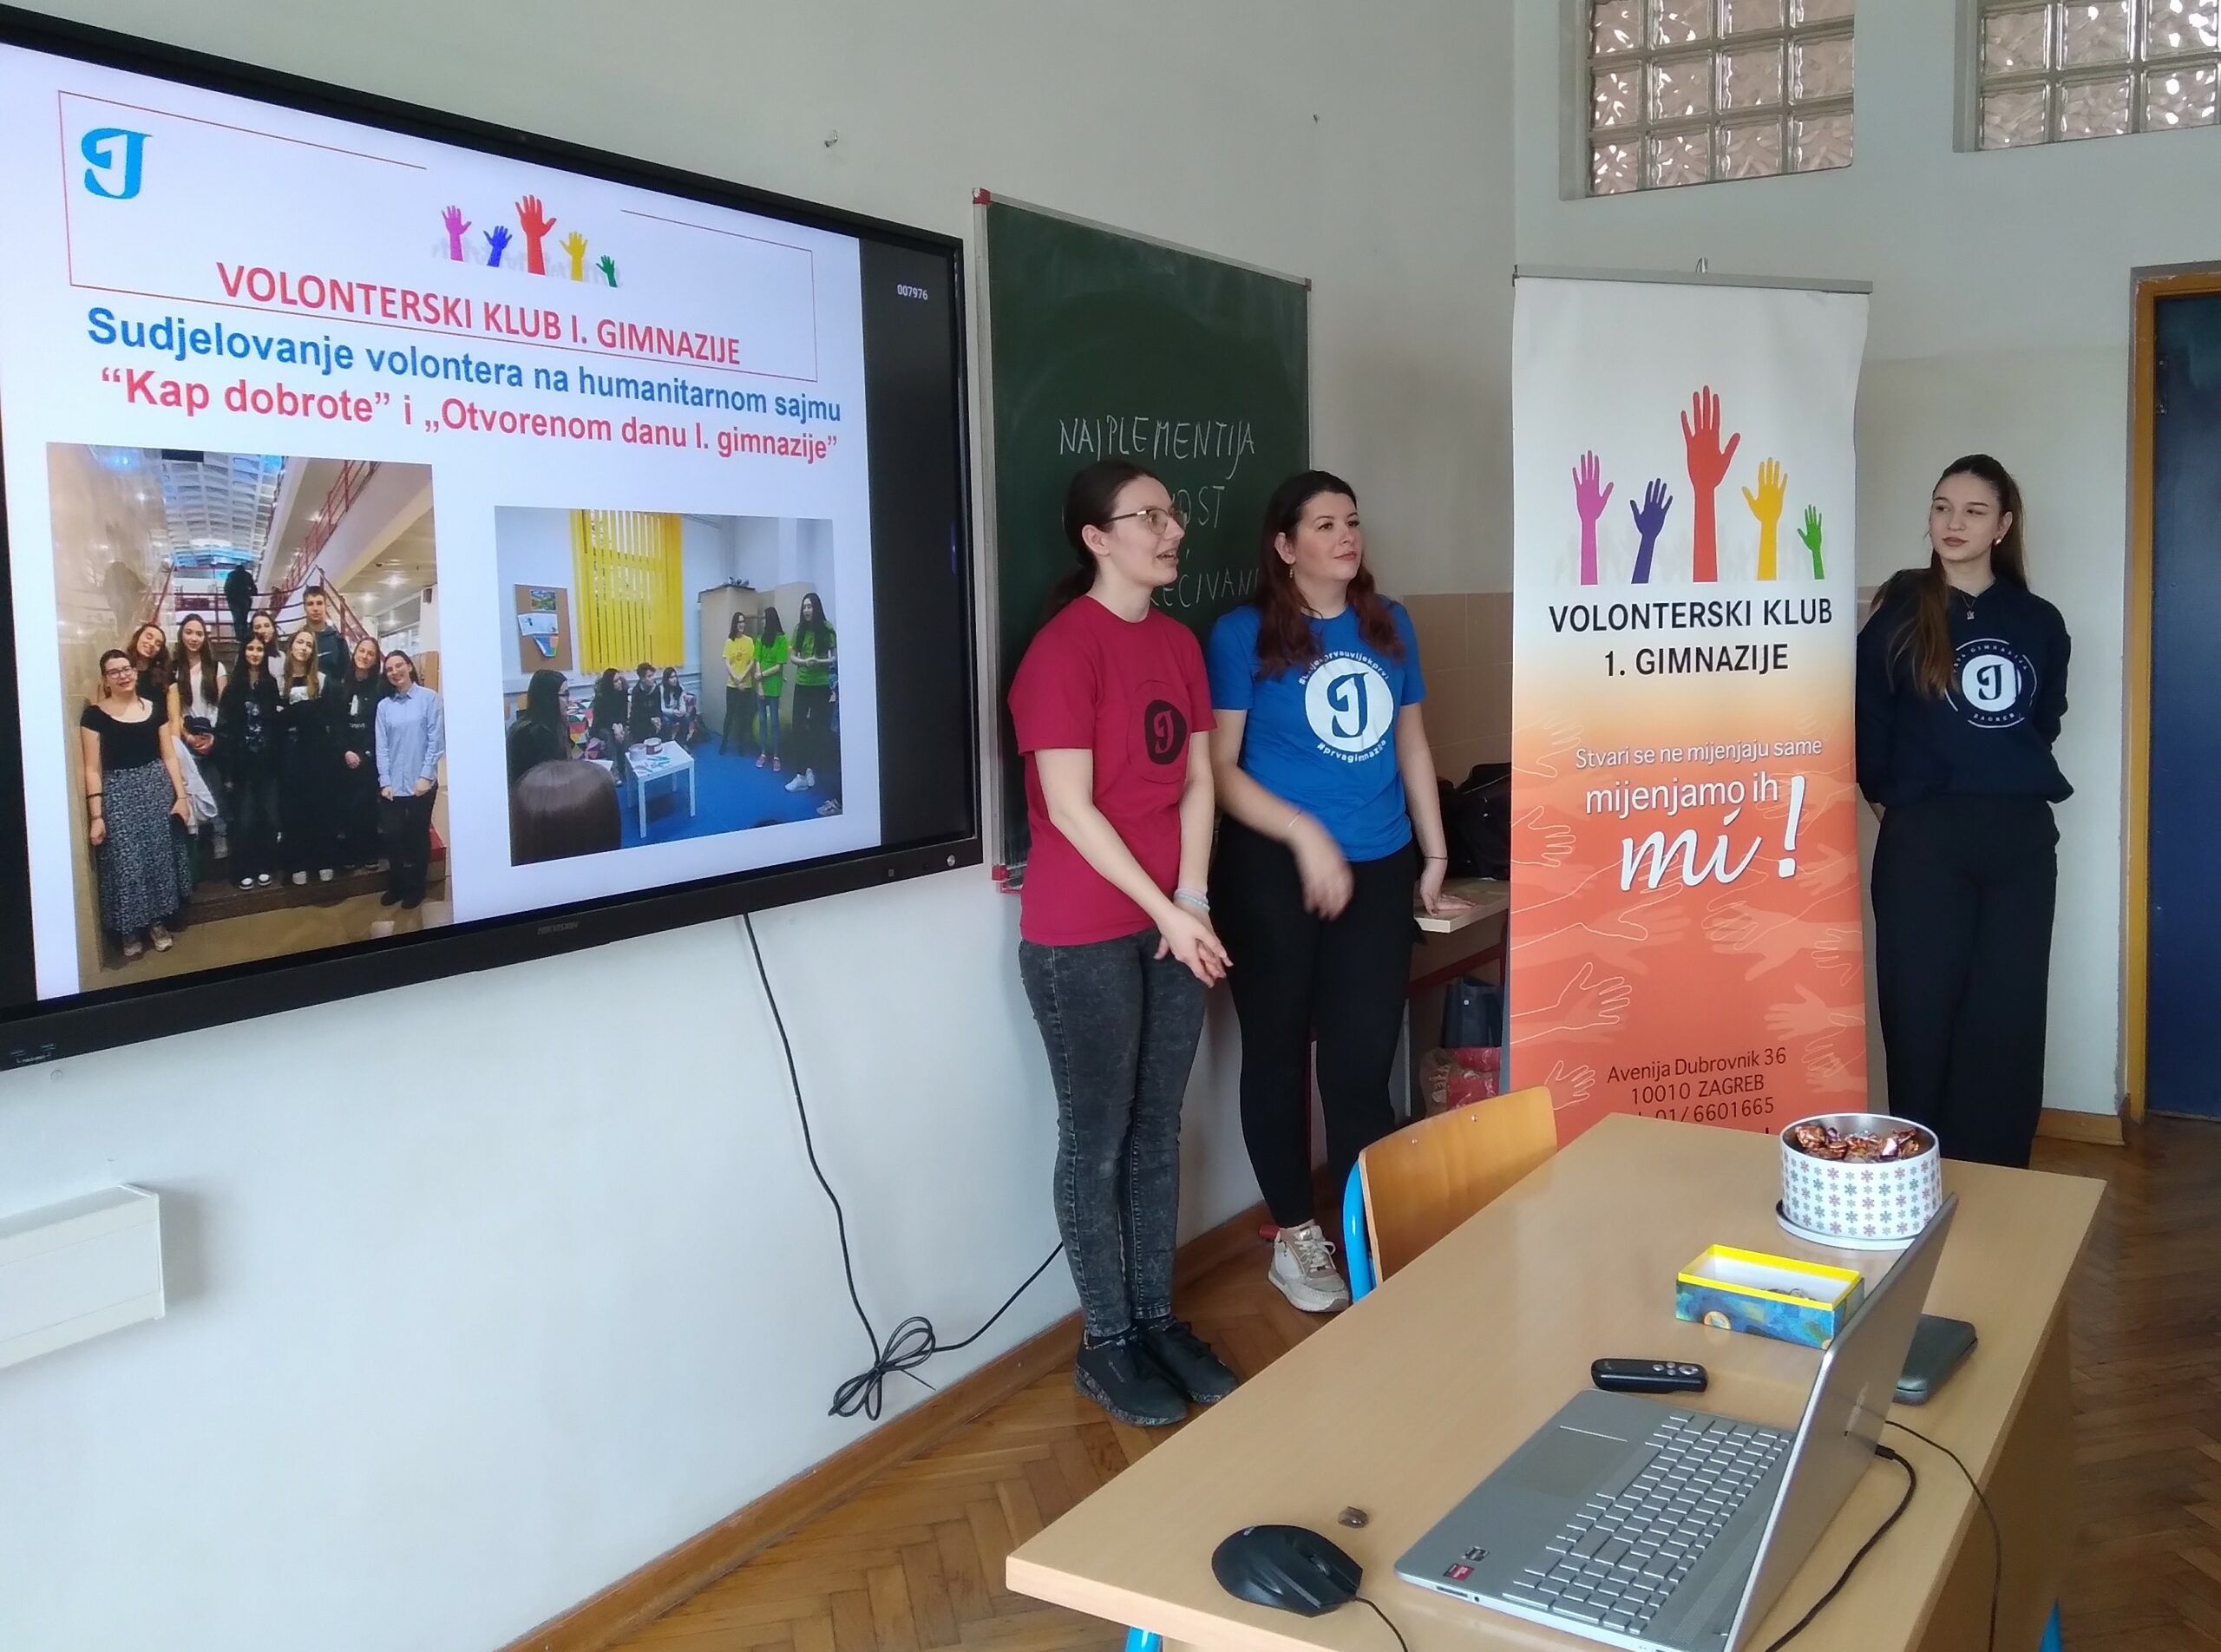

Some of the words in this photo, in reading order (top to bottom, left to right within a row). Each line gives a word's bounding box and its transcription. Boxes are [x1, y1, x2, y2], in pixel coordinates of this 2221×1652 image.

[897, 284, 928, 300] 007976
[216, 261, 473, 330] VOLONTERSKI
[483, 302, 561, 340] KLUB
[572, 314, 587, 344] I.
[597, 318, 741, 366] GIMNAZIJE
[88, 306, 354, 376] Sudjelovanje
[364, 346, 523, 387] volontera
[534, 366, 569, 393] na
[579, 365, 767, 414] humanitarnom
[775, 391, 842, 424] sajmu
[403, 395, 412, 425] i
[620, 416, 687, 448] danu
[1549, 600, 1752, 633] VOLONTERSKI
[1763, 597, 1832, 626] KLUB
[1605, 650, 1626, 677] 1.
[1635, 643, 1789, 675] GIMNAZIJE
[1575, 746, 1630, 769] Stvari
[1634, 747, 1655, 764] se
[1660, 746, 1683, 764] ne
[1687, 741, 1770, 765] mijenjaju
[1773, 738, 1823, 757] same
[1585, 778, 1745, 819] mijenjamo
[1753, 770, 1778, 803] ih
[1607, 1061, 1671, 1084] Avenija
[1674, 1050, 1760, 1077] Dubrovnik
[1764, 1046, 1787, 1066] 36
[1631, 1083, 1691, 1105] 10010
[1698, 1074, 1765, 1098] ZAGREB
[1694, 1097, 1775, 1123] 6601665
